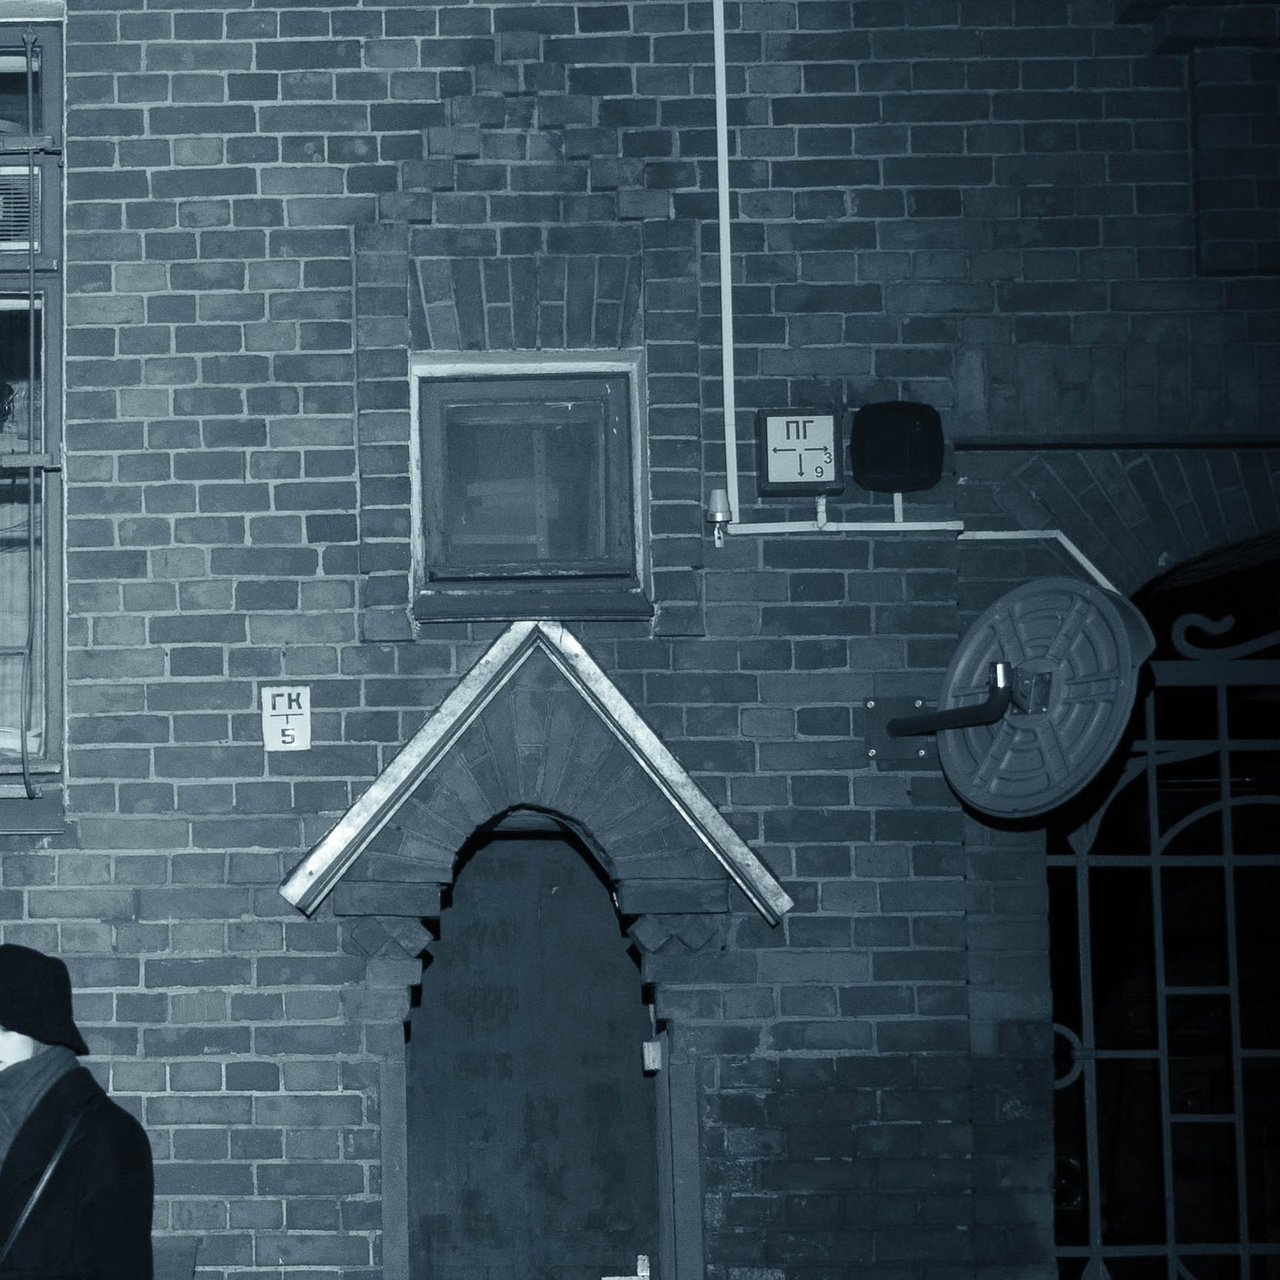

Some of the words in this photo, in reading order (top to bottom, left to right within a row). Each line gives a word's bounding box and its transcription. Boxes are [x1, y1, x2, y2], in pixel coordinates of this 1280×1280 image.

[785, 420, 815, 440] ПГ
[823, 451, 833, 464] 3
[814, 466, 824, 478] 9
[271, 692, 303, 711] ГК
[281, 728, 295, 745] 5
